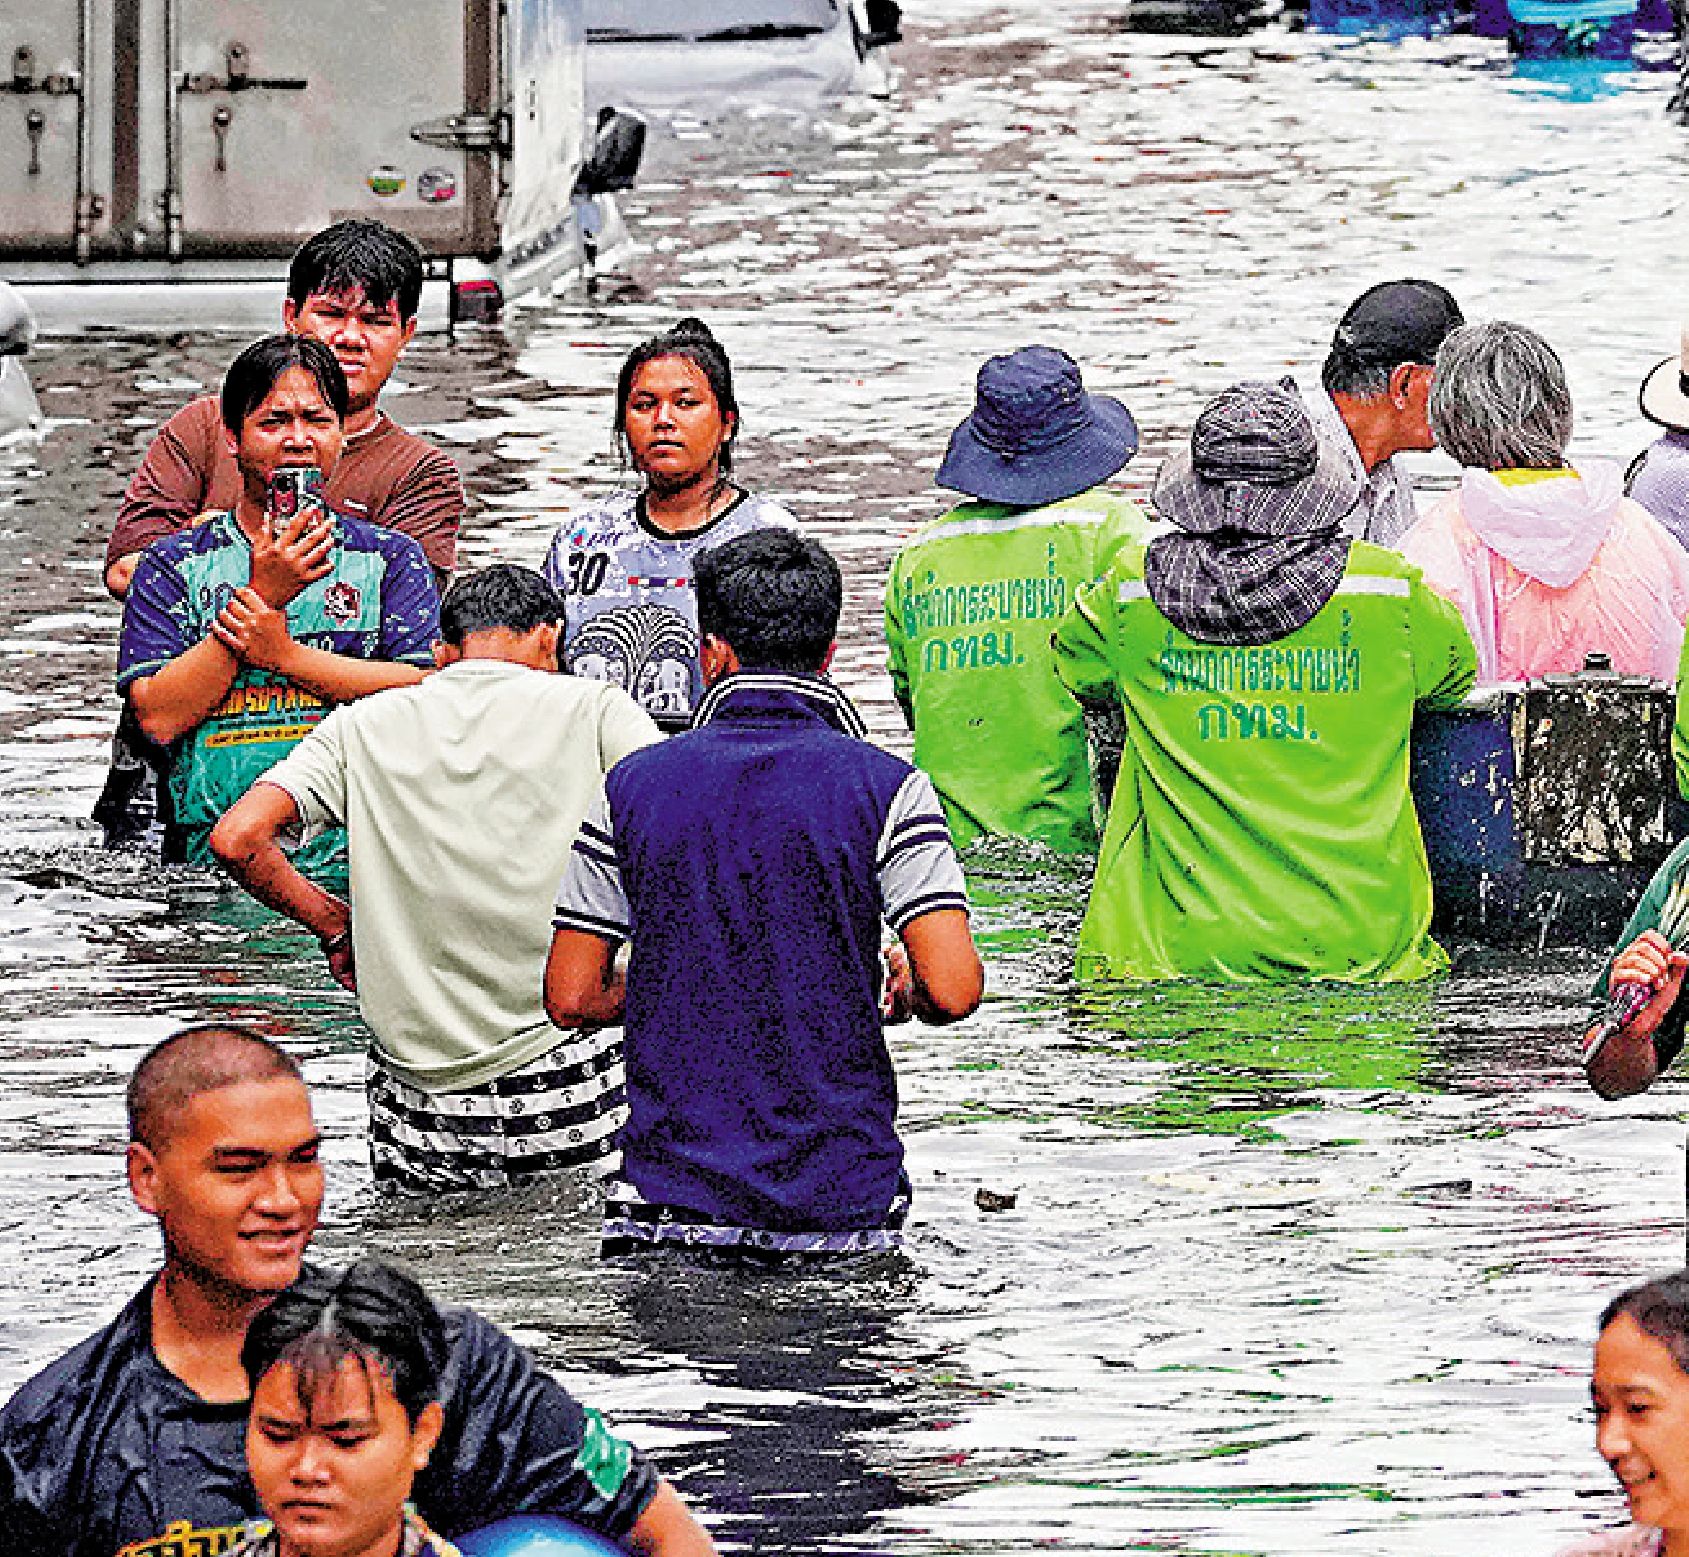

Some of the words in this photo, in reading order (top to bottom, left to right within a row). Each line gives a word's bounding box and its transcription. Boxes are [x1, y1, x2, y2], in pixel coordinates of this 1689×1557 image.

[568, 552, 608, 595] 30
[924, 631, 1025, 673] กทม.
[1198, 701, 1319, 742] กทม.
